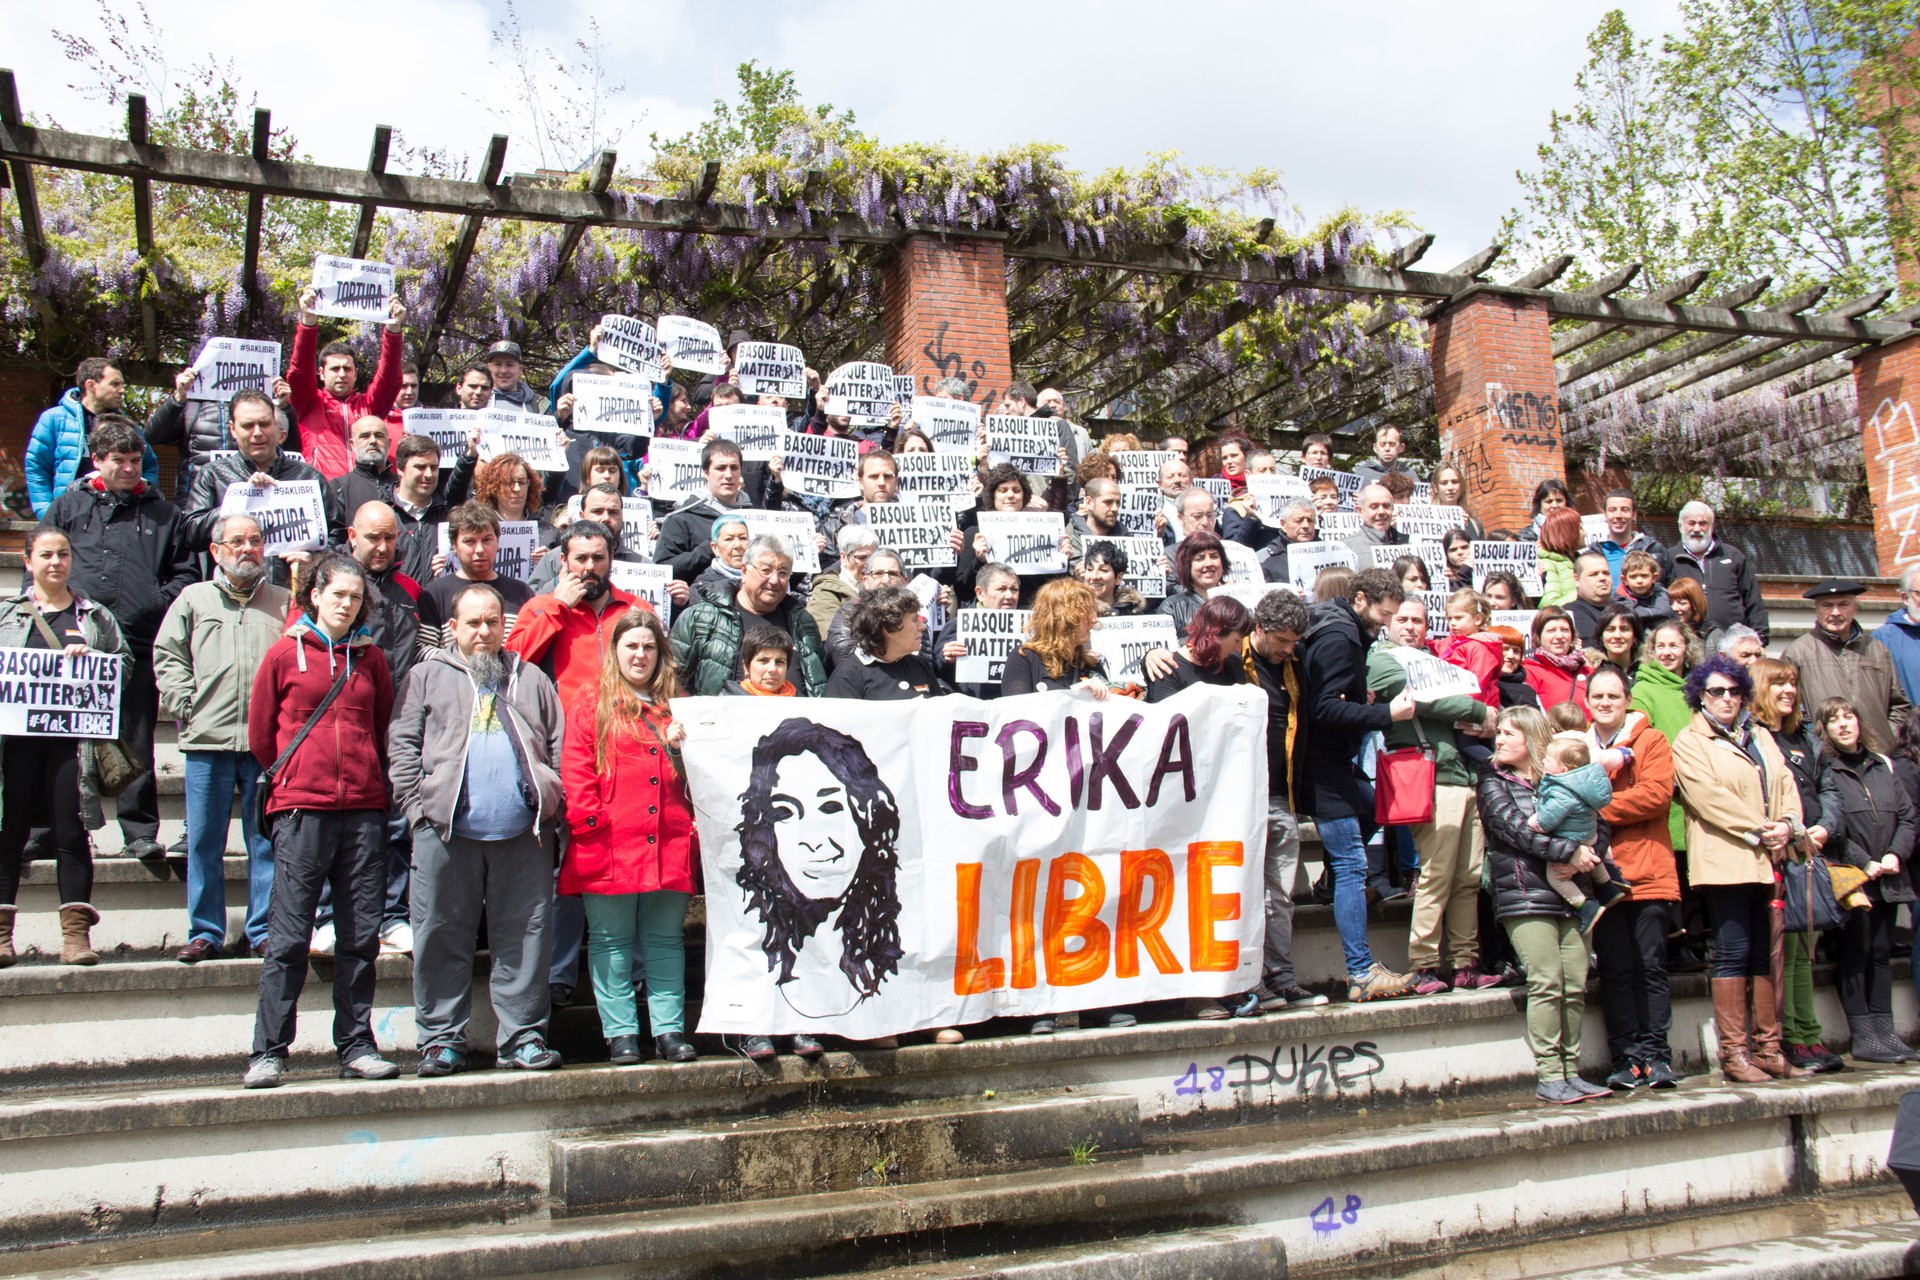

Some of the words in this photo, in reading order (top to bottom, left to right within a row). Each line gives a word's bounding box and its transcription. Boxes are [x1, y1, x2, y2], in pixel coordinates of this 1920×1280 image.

[361, 265, 391, 275] #9AKLIBRE
[336, 280, 382, 311] TORTURA
[605, 316, 643, 339] BASQUE
[240, 344, 275, 354] #9AKLIBRE
[602, 331, 642, 357] MATTER
[678, 336, 713, 364] TORTURA
[739, 345, 776, 361] BASQUE
[780, 347, 803, 363] LIVES
[215, 362, 265, 391] TORTURA
[738, 362, 781, 378] MATTER
[870, 365, 892, 382] LIVES
[829, 382, 872, 398] MATTER
[893, 377, 913, 392] IVES
[599, 396, 642, 425] TORTURA
[932, 417, 970, 445] TORTURA
[989, 417, 1028, 435] BASQUE
[1033, 419, 1057, 436] LIVES
[734, 425, 776, 451] TORTURA
[784, 434, 826, 456] BASQUE
[831, 440, 856, 460] LIVES
[991, 437, 1036, 454] MATTER
[783, 456, 832, 476] MATTER
[940, 456, 969, 471] LIVES
[1120, 453, 1149, 469] ASQUE
[273, 486, 314, 495] #9AKLIBRE
[899, 476, 944, 491] MATTER
[1210, 481, 1230, 495] LIVES
[1338, 472, 1361, 491] LIVES
[1131, 493, 1157, 511] LIVES
[870, 505, 917, 525] BASQUE
[922, 505, 951, 523] LIVES
[1398, 507, 1434, 520] BASQUE
[1438, 507, 1461, 521] LIVES
[500, 526, 533, 535] 9AKLIBRE
[875, 527, 927, 546] MATTER
[1402, 522, 1442, 536] MATTER
[1007, 534, 1053, 564] TORTURA
[1132, 540, 1160, 556] LIVES
[1474, 544, 1510, 559] BASQUE
[1513, 544, 1536, 560] LIVES
[627, 568, 666, 578] #9AKLIBRE
[961, 612, 1014, 634] BASQUE
[71, 655, 118, 681] LIVES
[0, 681, 75, 706] MATTER
[71, 713, 111, 734] LIBRE
[948, 712, 1196, 820] ERIKA
[954, 841, 1244, 996] LIBRE
[1174, 1062, 1225, 1096] 18
[1310, 1194, 1361, 1232] 18
